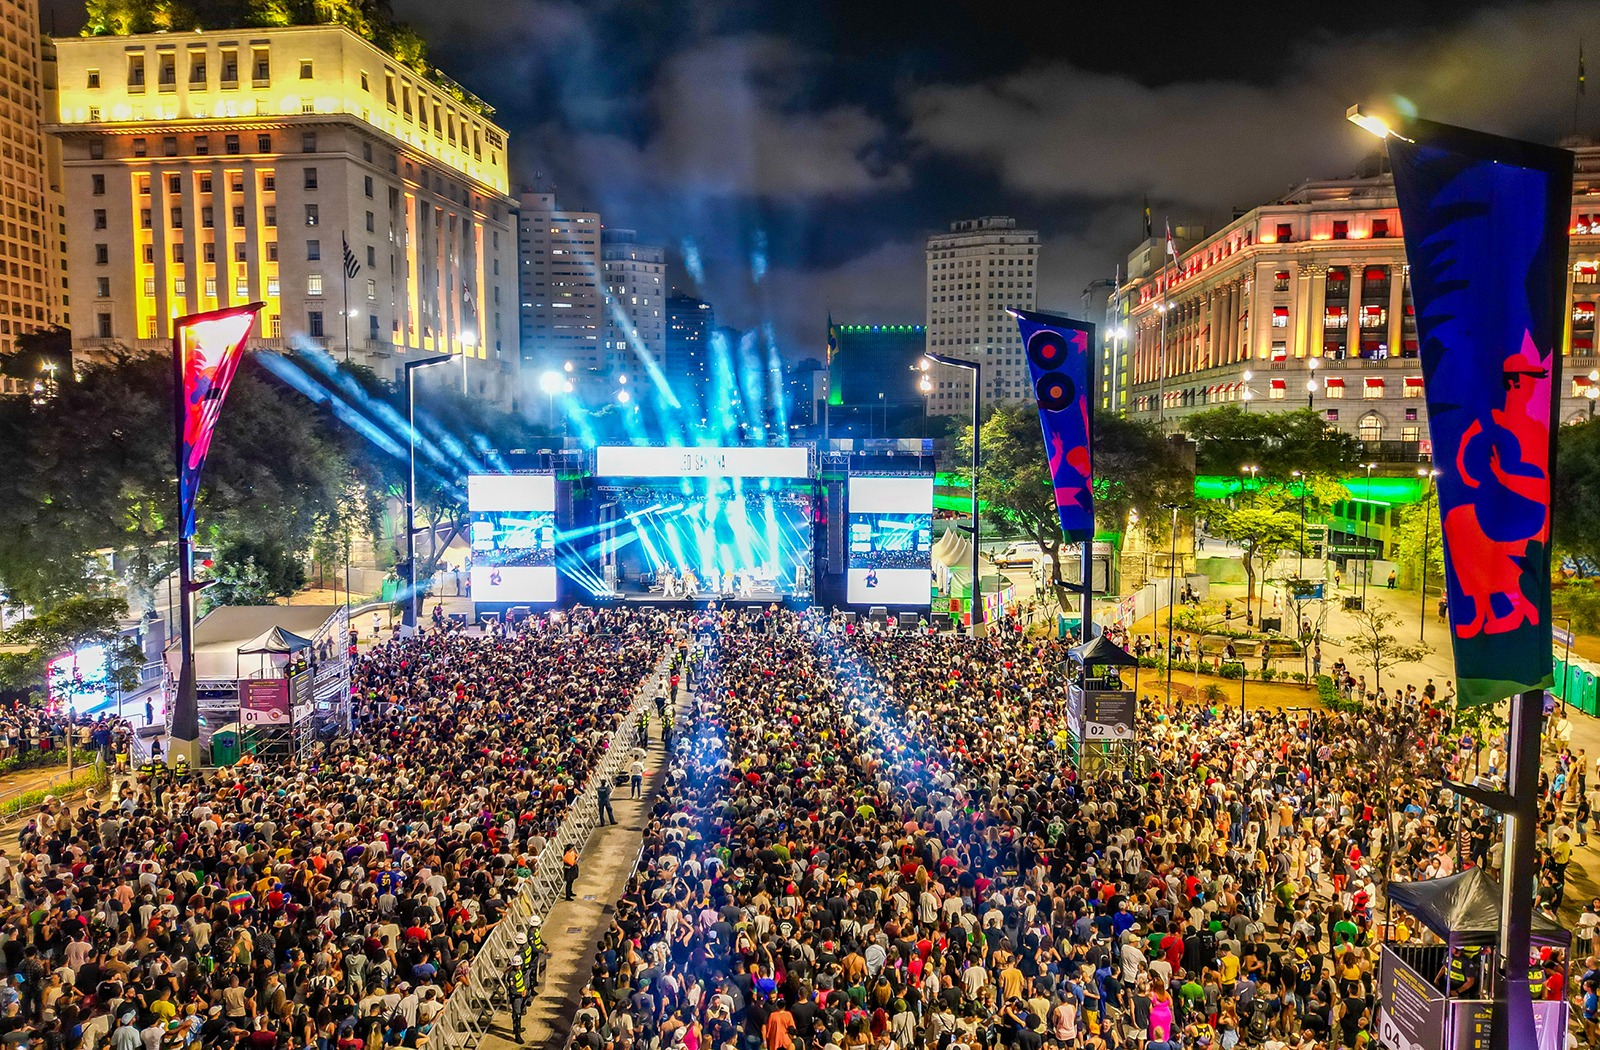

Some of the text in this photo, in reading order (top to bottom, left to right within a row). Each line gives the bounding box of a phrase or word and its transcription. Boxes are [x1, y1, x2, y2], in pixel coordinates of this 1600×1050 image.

[246, 712, 258, 721] 01
[1091, 726, 1104, 735] 02
[1300, 969, 1311, 981] 45
[1385, 1022, 1401, 1049] 04
